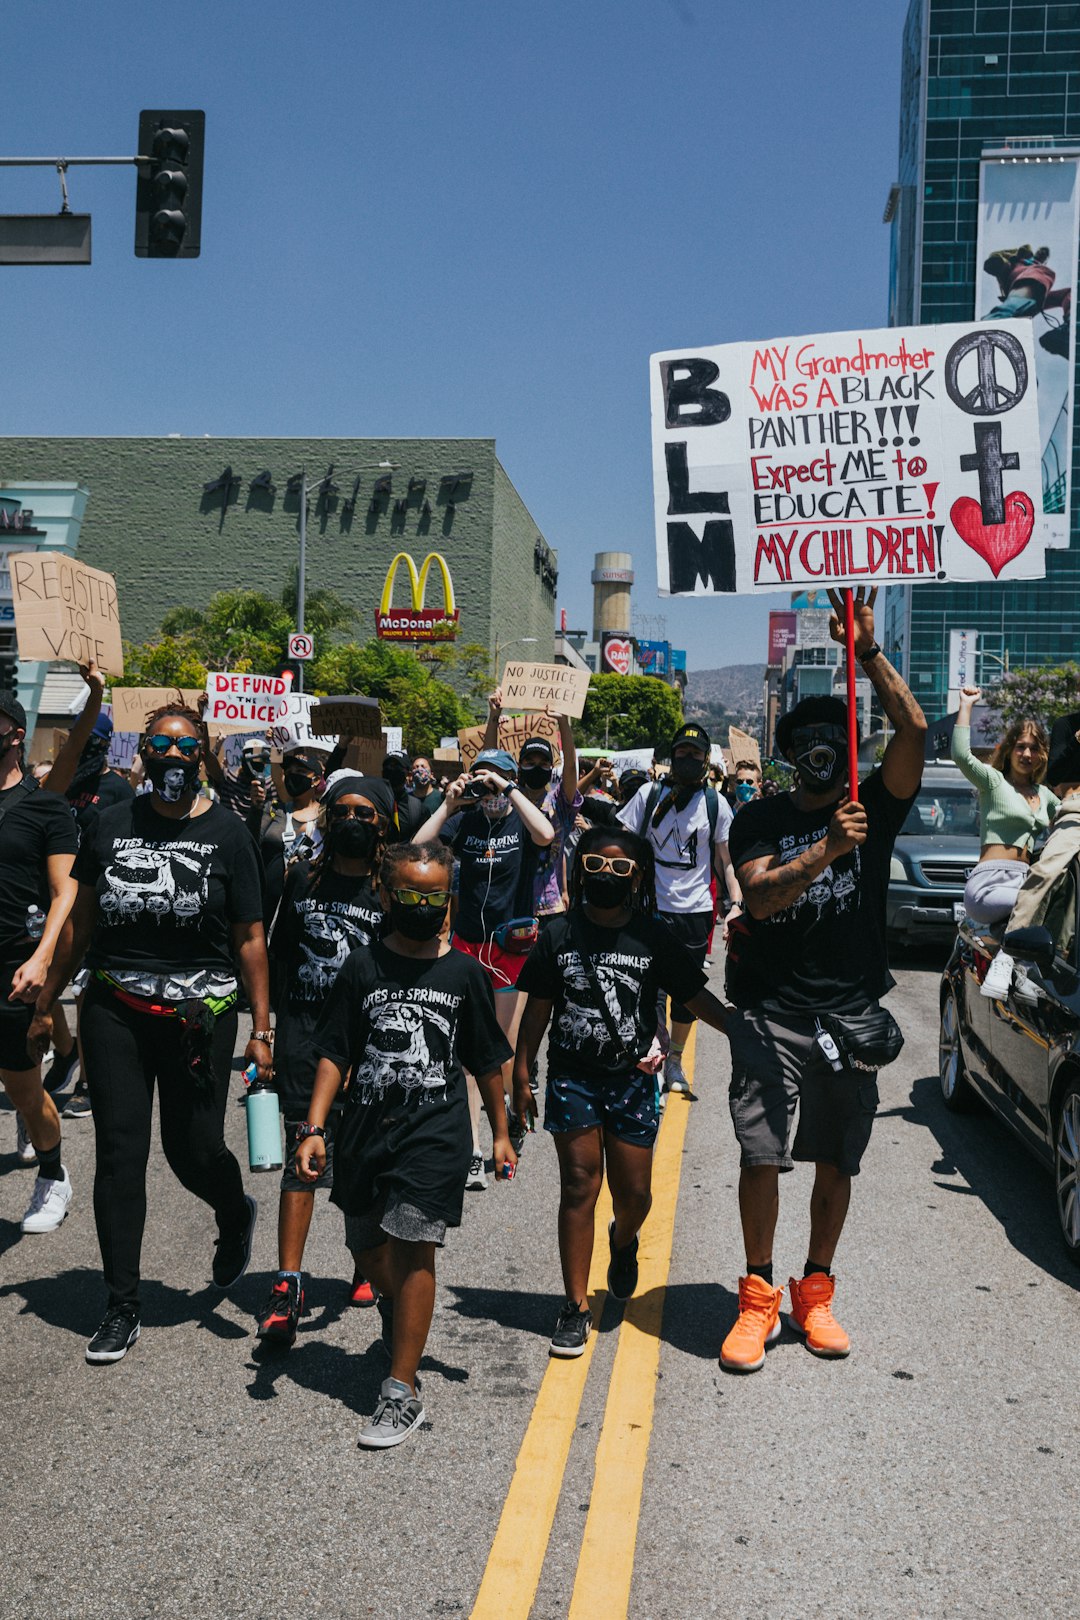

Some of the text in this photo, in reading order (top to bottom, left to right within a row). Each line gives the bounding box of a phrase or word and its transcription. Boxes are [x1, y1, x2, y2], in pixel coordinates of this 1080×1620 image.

[750, 338, 936, 386] MY Grandmother
[749, 370, 935, 412] WAS A BLACK
[749, 405, 921, 448] PANTHER!!!
[751, 448, 836, 493] Expect
[840, 449, 887, 482] ME
[755, 482, 941, 523] EDUCATE!
[754, 525, 946, 581] MY CHILDREN!
[15, 561, 119, 621] REGISTER
[66, 606, 85, 631] TO
[42, 628, 108, 670] VOTE
[216, 675, 285, 695] DEFUND
[507, 667, 576, 688] NO JUSTICE,
[236, 696, 256, 704] THE
[507, 685, 576, 704] NO PEACE!
[214, 700, 275, 722] POLICE
[272, 726, 290, 747] NO
[462, 715, 556, 759] BLAK LIVES
[499, 732, 533, 751] ATTER
[612, 758, 641, 769] BLACK
[112, 838, 143, 849] RITES
[159, 841, 215, 855] SPRINKLES
[331, 902, 384, 924] SPRINKLES
[600, 952, 651, 970] SPRINKLES
